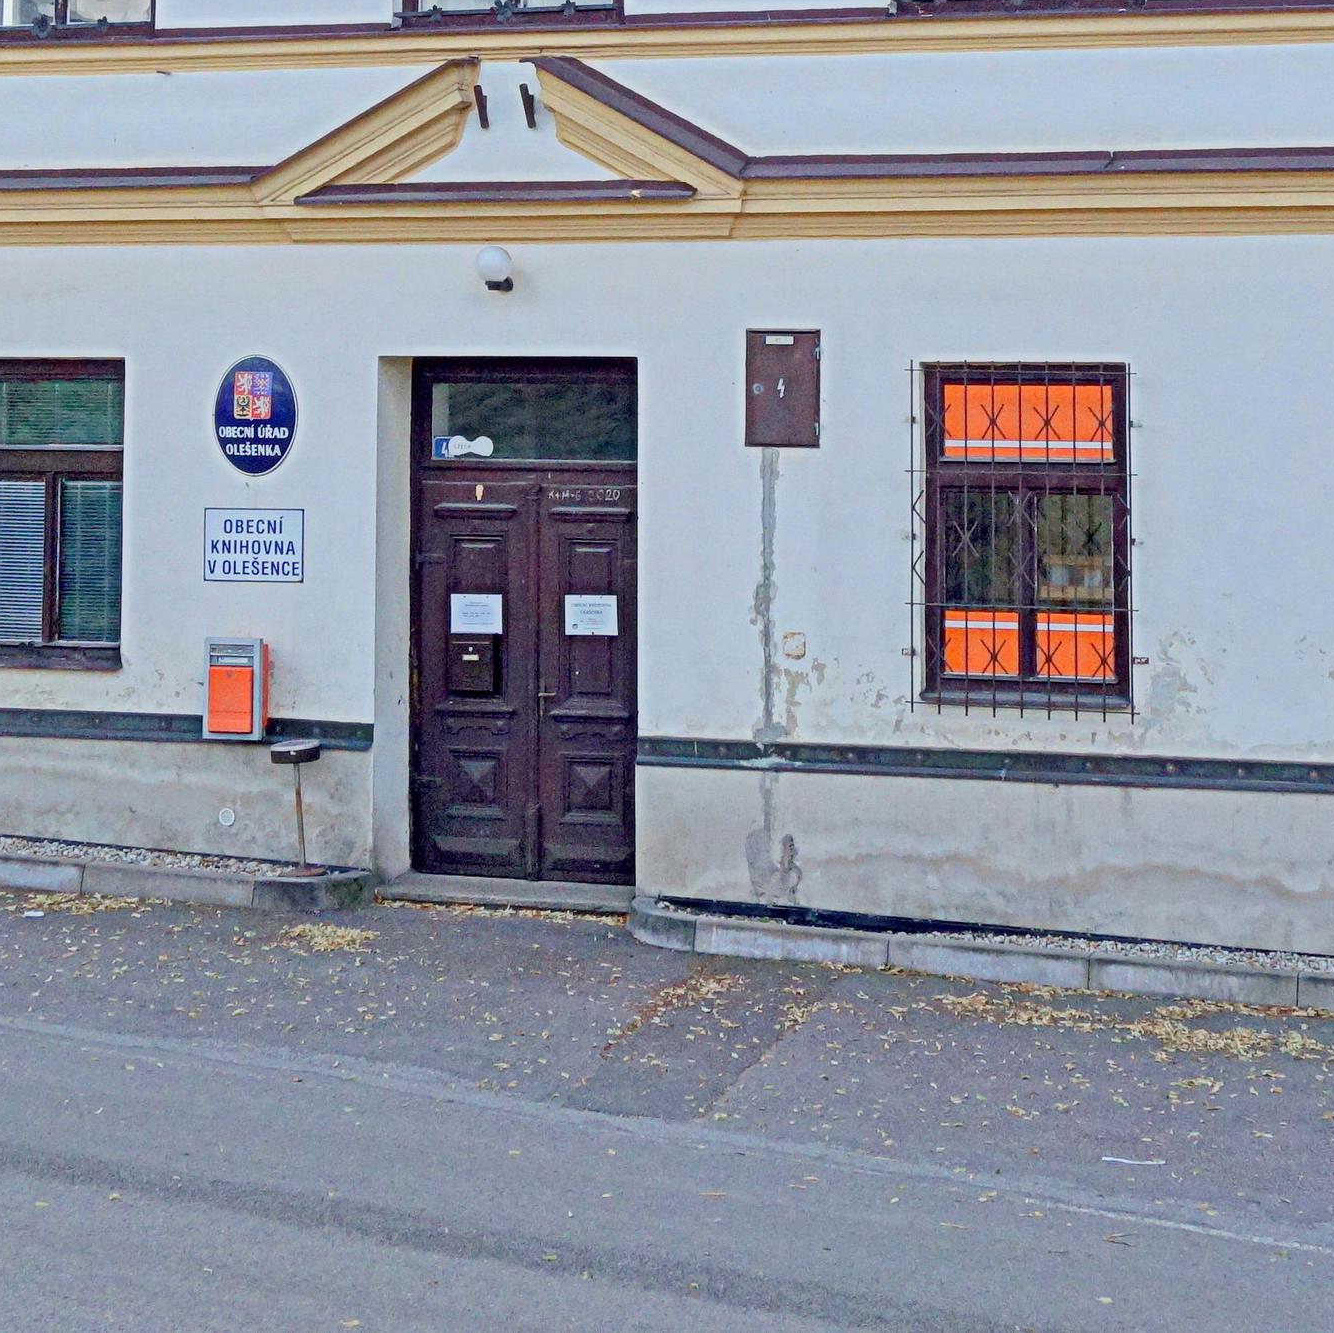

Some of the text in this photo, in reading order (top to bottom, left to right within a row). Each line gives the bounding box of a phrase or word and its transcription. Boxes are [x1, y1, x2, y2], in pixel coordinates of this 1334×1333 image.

[218, 424, 289, 439] OBECNÍ ÚŘAD
[225, 441, 282, 457] OLEŠENKA
[223, 516, 284, 535] OBECNÍ
[210, 539, 296, 556] KNIHOVNA
[207, 556, 300, 577] V OLEŠENCE
